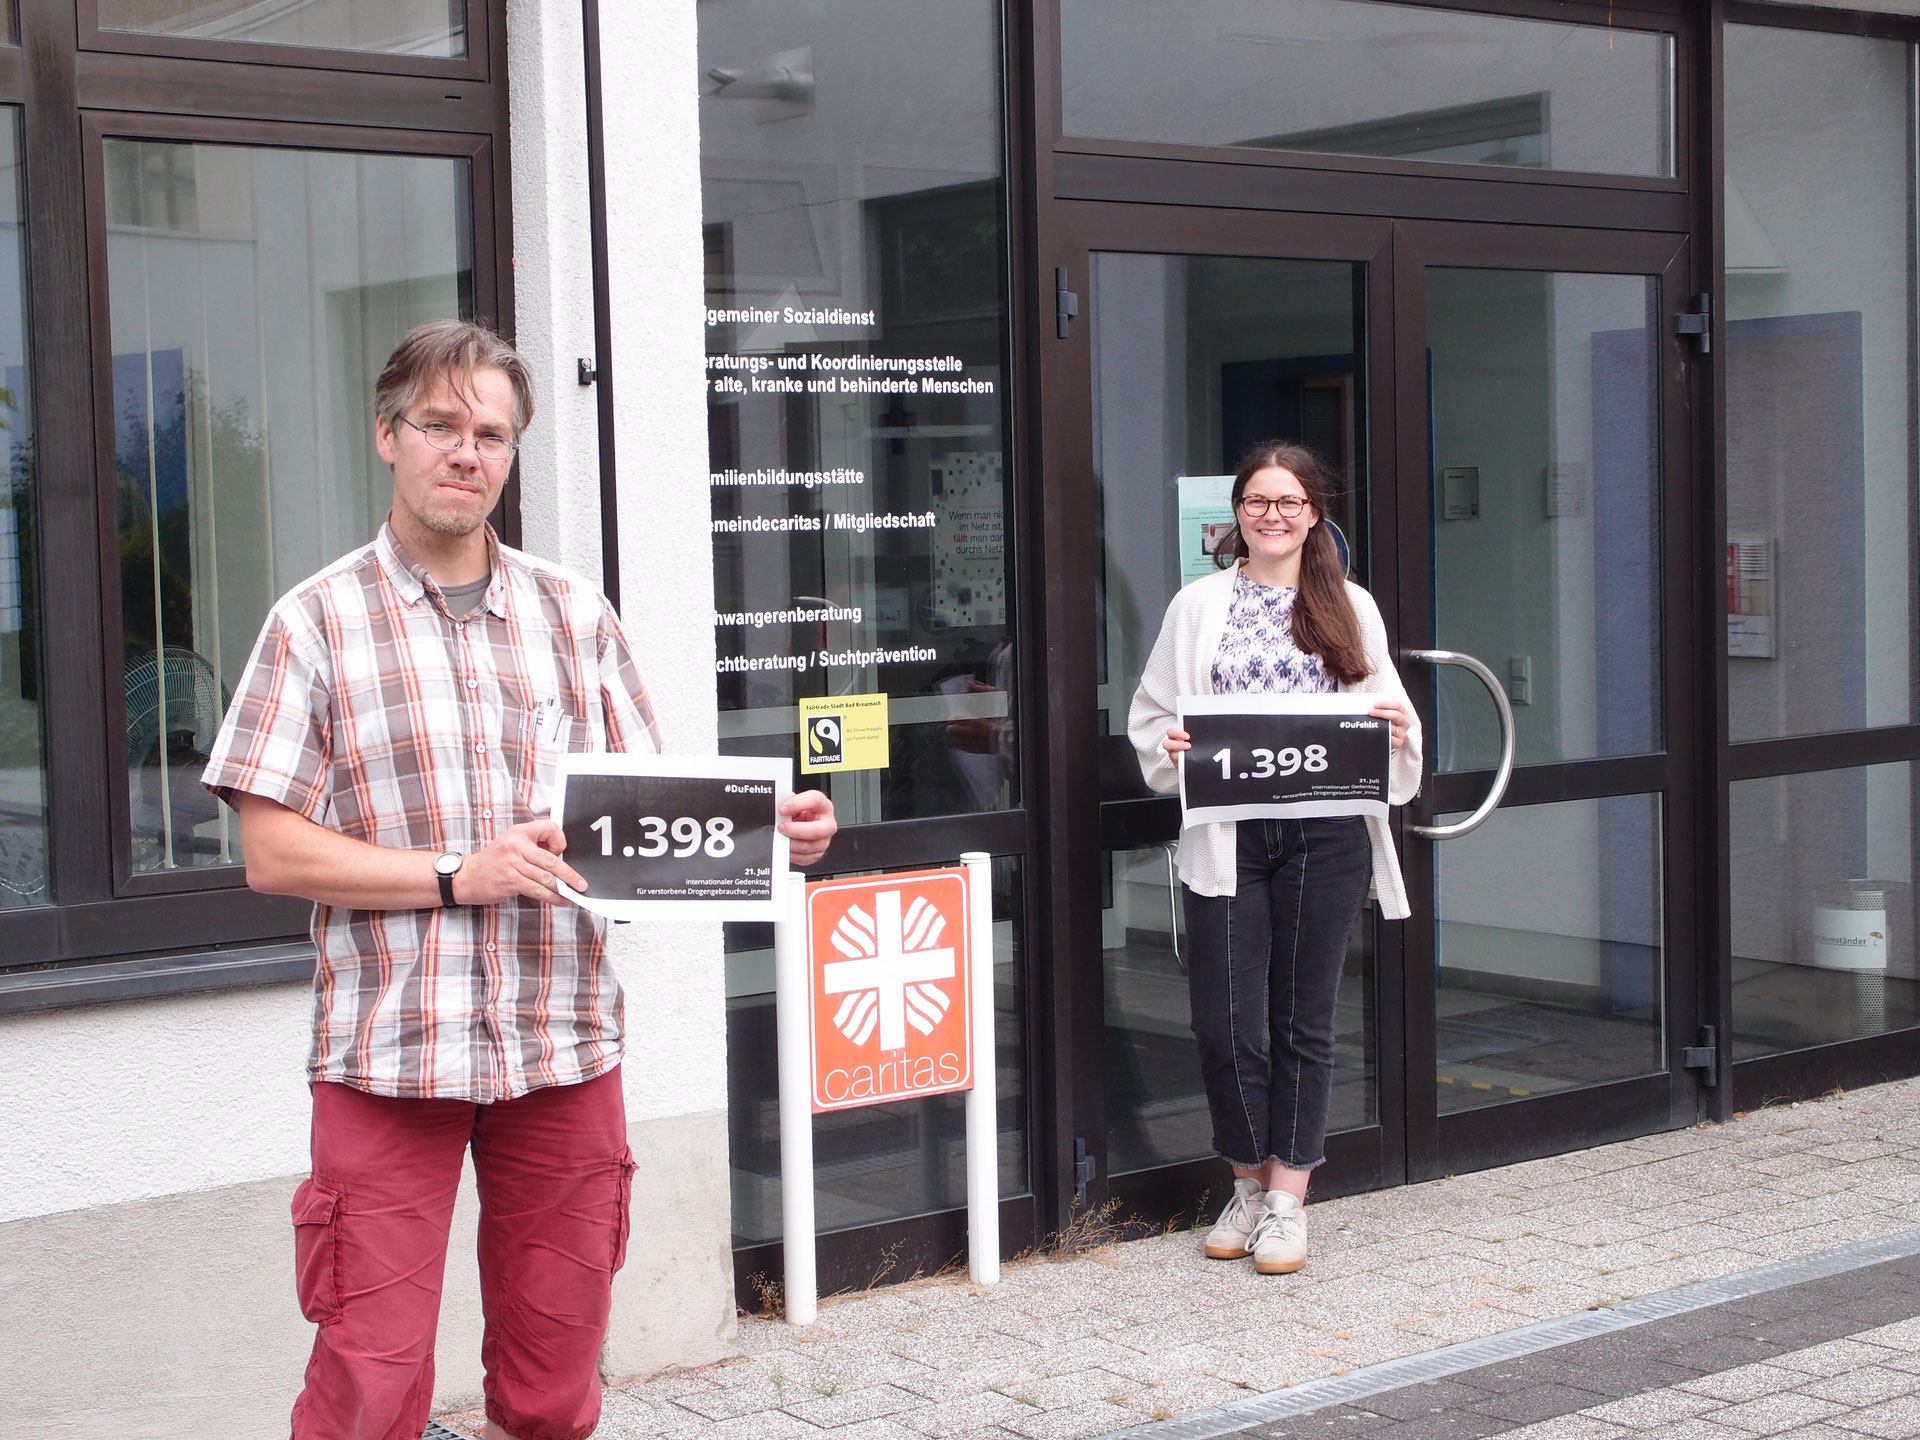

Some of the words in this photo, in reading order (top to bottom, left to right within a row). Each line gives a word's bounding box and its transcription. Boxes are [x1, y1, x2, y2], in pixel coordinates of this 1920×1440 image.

[783, 306, 875, 326] Sozialdienst
[777, 354, 807, 370] und
[811, 354, 963, 375] Koordinierungsstelle
[714, 375, 748, 395] alte,
[751, 376, 803, 393] kranke
[807, 376, 836, 393] und
[840, 376, 918, 394] behinderte
[922, 377, 994, 394] Menschen
[709, 467, 864, 489] milienbildungsstätte
[949, 511, 972, 521] Wenn
[974, 511, 991, 520] man
[711, 514, 821, 533] meindecaritas
[824, 513, 830, 530] /
[833, 511, 936, 533] Mitgliedschaft
[971, 522, 990, 531] Netz
[953, 533, 968, 543] fällt
[970, 534, 988, 543] man
[955, 545, 982, 555] durchs
[810, 651, 816, 668] /
[819, 645, 937, 669] Suchtprävention
[1339, 721, 1379, 729] #DuFehlst
[810, 754, 841, 763] FAIRTRADE
[1212, 744, 1328, 779] 1.398
[724, 784, 773, 794] #DuFehlst
[590, 815, 735, 859] 1.398
[744, 867, 756, 876] 21.
[756, 867, 771, 877] Juli
[685, 878, 734, 886] internationaler
[734, 878, 770, 888] Gedenktag
[636, 887, 646, 895] für
[647, 887, 687, 895] verstorbene
[687, 887, 770, 898] Drogengebraucher_innen
[824, 1050, 960, 1101] caritas
